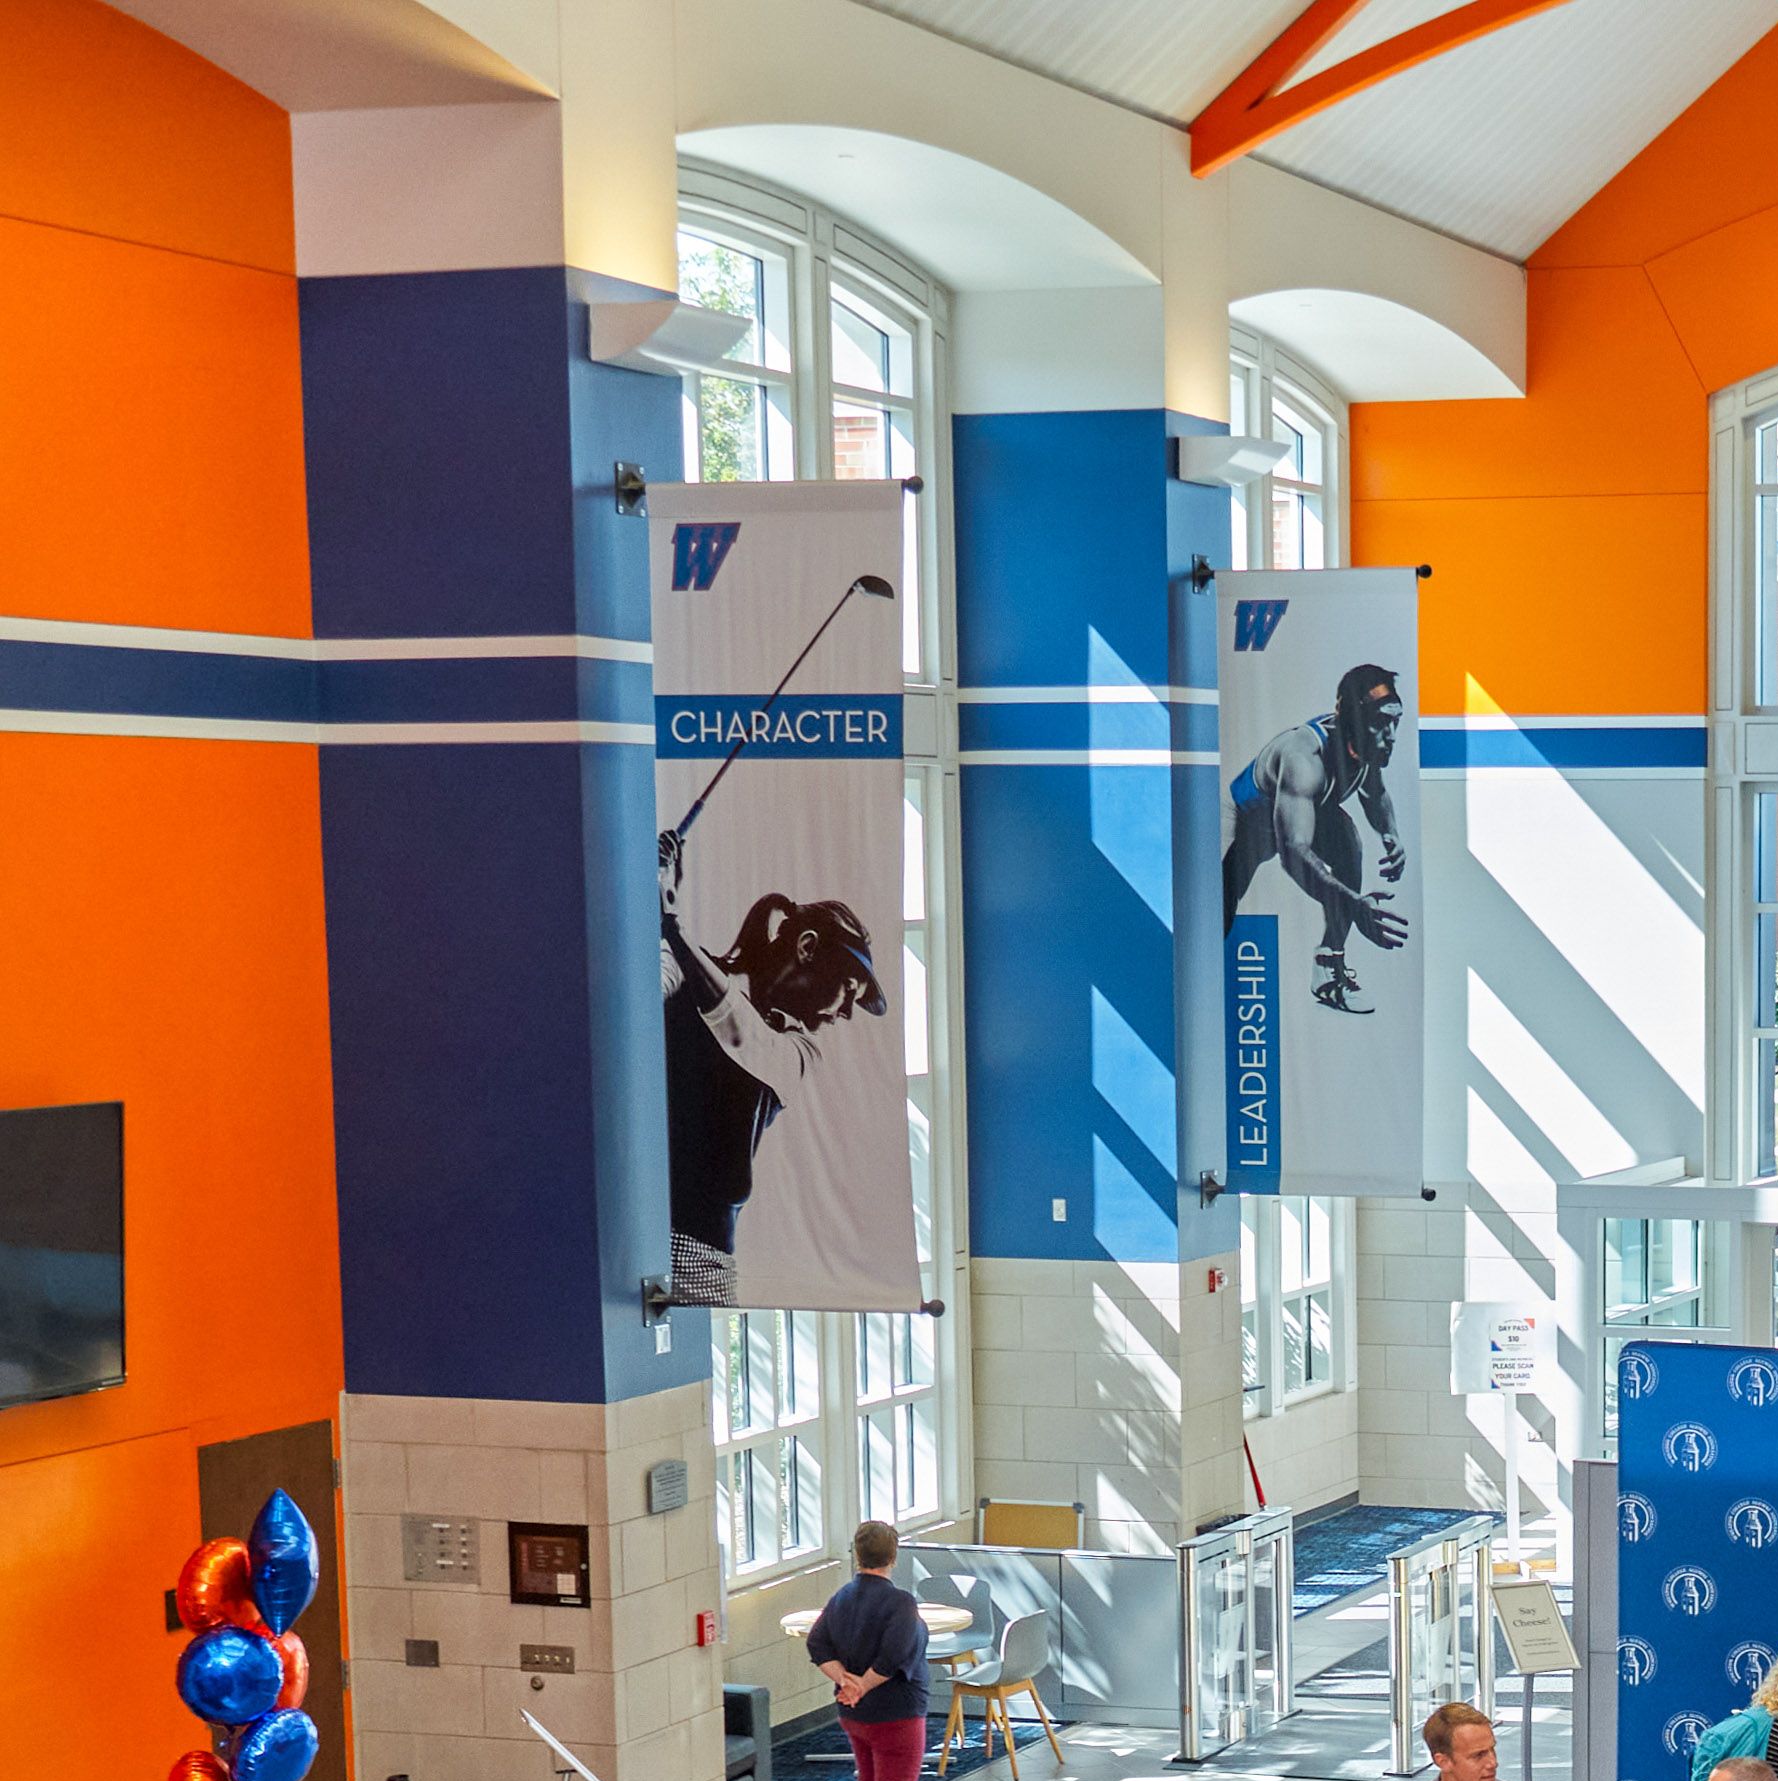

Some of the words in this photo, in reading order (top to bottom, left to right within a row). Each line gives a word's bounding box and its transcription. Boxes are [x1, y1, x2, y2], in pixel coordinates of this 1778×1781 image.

[671, 522, 741, 591] W
[1233, 599, 1290, 652] W
[670, 709, 890, 745] CHARACTER
[1240, 940, 1269, 1168] LEADERSHIP
[1518, 1607, 1537, 1615] Say
